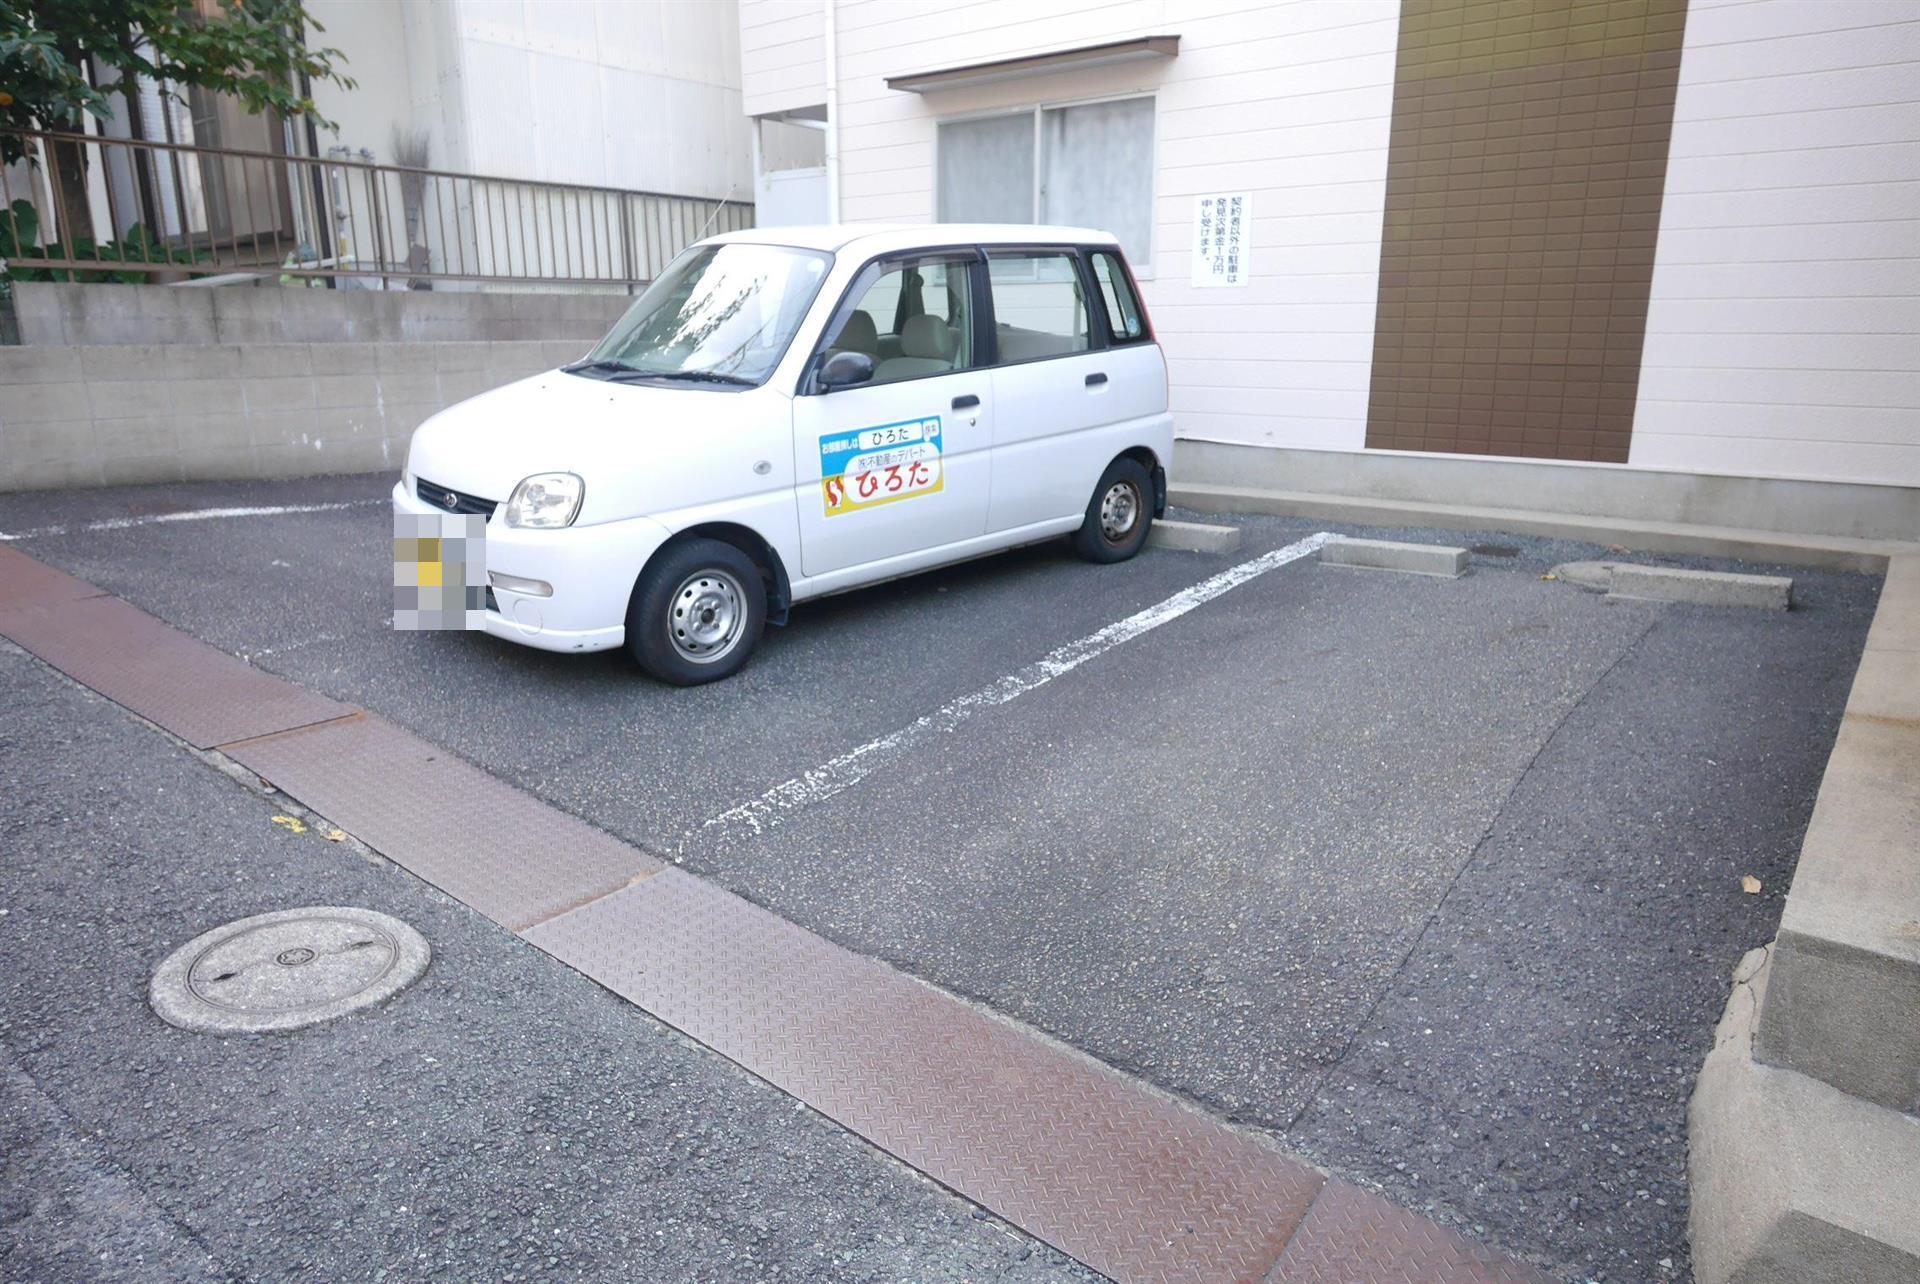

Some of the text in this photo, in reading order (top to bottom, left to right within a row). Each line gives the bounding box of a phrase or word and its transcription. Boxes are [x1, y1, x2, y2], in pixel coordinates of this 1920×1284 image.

[1227, 197, 1242, 283] 契約者以外の駐車は
[872, 428, 909, 446] ひろた
[856, 460, 928, 497] ひろた
